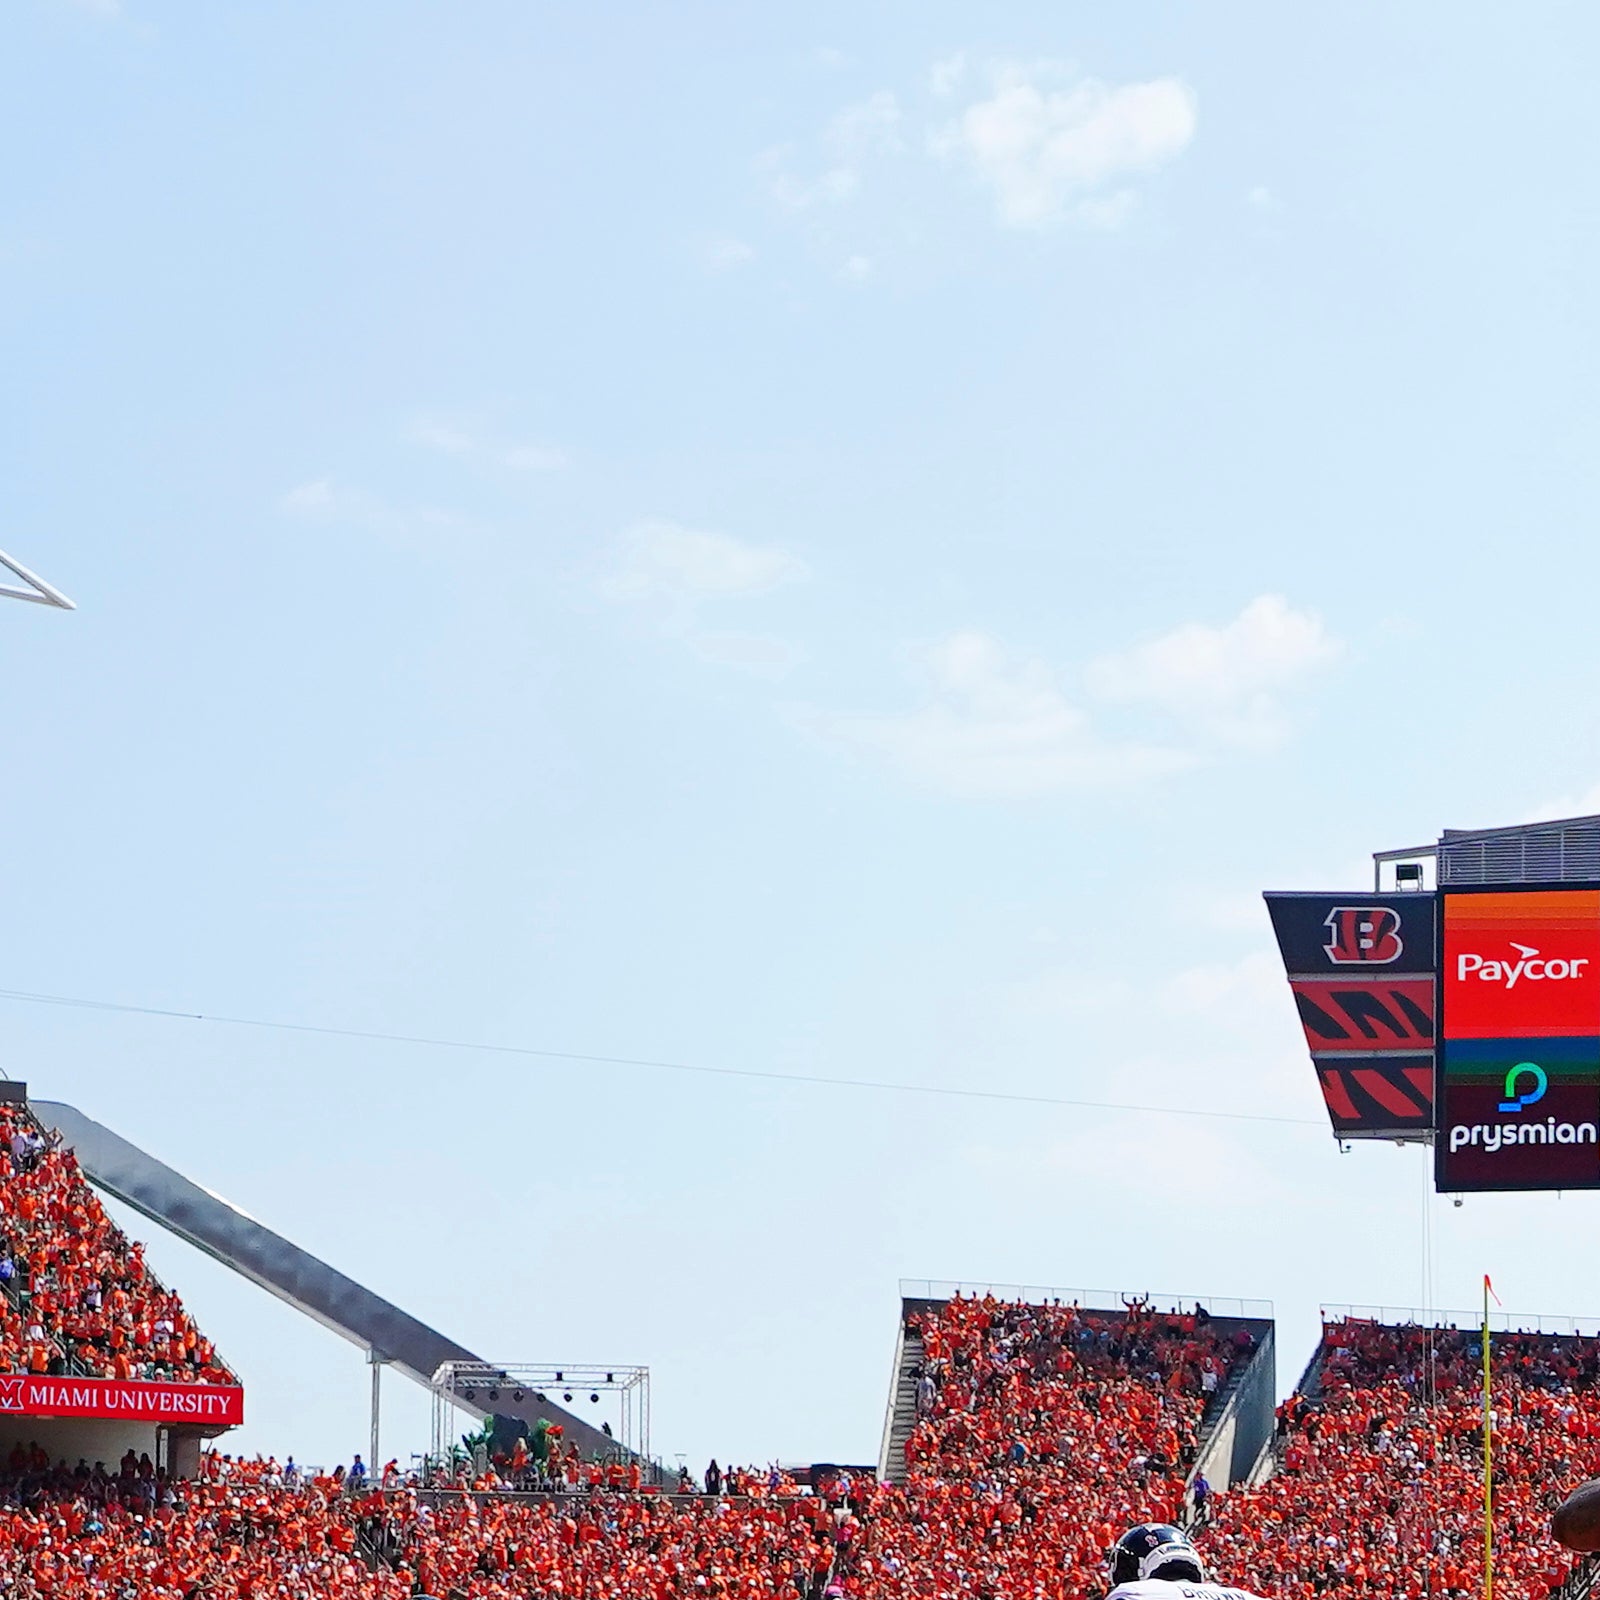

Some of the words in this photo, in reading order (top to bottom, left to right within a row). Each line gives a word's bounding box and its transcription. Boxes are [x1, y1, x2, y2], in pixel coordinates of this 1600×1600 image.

[1323, 907, 1404, 964] B
[1457, 951, 1589, 989] Paycor
[1450, 1116, 1597, 1153] prysmian
[29, 1385, 98, 1408] MIAMI
[104, 1388, 231, 1414] UNIVERSITY
